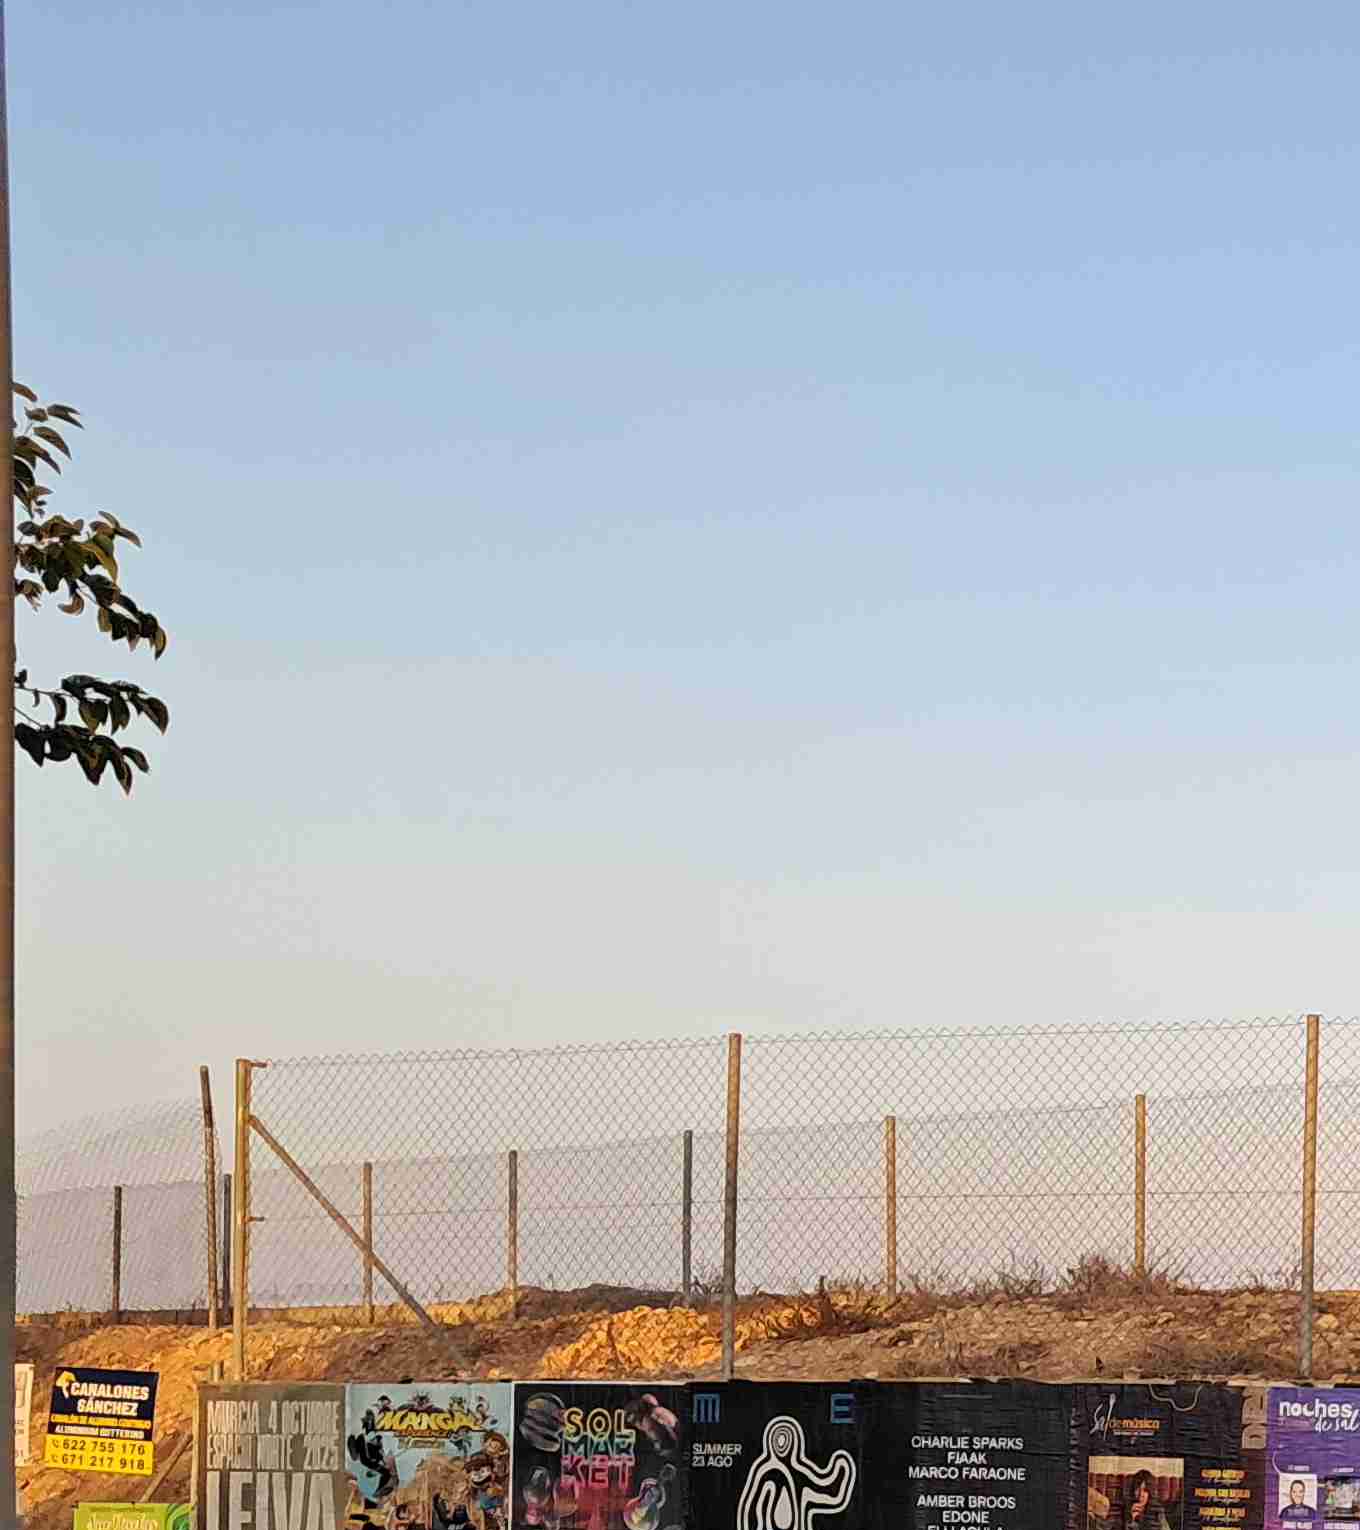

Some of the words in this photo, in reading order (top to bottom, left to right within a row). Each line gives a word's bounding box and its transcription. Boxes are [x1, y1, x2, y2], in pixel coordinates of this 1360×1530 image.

[70, 1382, 150, 1401] CANALONES
[77, 1396, 139, 1417] SÁNCHEZ
[1279, 1398, 1354, 1418] noches
[268, 1400, 278, 1434] 4
[376, 1409, 480, 1432] MANGA
[564, 1407, 637, 1443] SOL
[1314, 1416, 1334, 1433] de
[1334, 1408, 1360, 1432] sal
[63, 1439, 86, 1450] 622
[91, 1441, 114, 1453] 755
[692, 1443, 742, 1456] SUMMER
[911, 1435, 970, 1449] CHARLIE
[972, 1436, 1024, 1450] SPARKS
[62, 1453, 84, 1466] 671
[90, 1455, 113, 1468] 217
[119, 1458, 146, 1471] 918
[691, 1455, 706, 1468] 23
[707, 1456, 733, 1468] AGO
[908, 1465, 959, 1480] MARCO
[961, 1466, 1027, 1481] FARAONE
[916, 1494, 966, 1508] AMBER
[967, 1495, 1017, 1509] BROOS
[942, 1510, 990, 1524] EDONE
